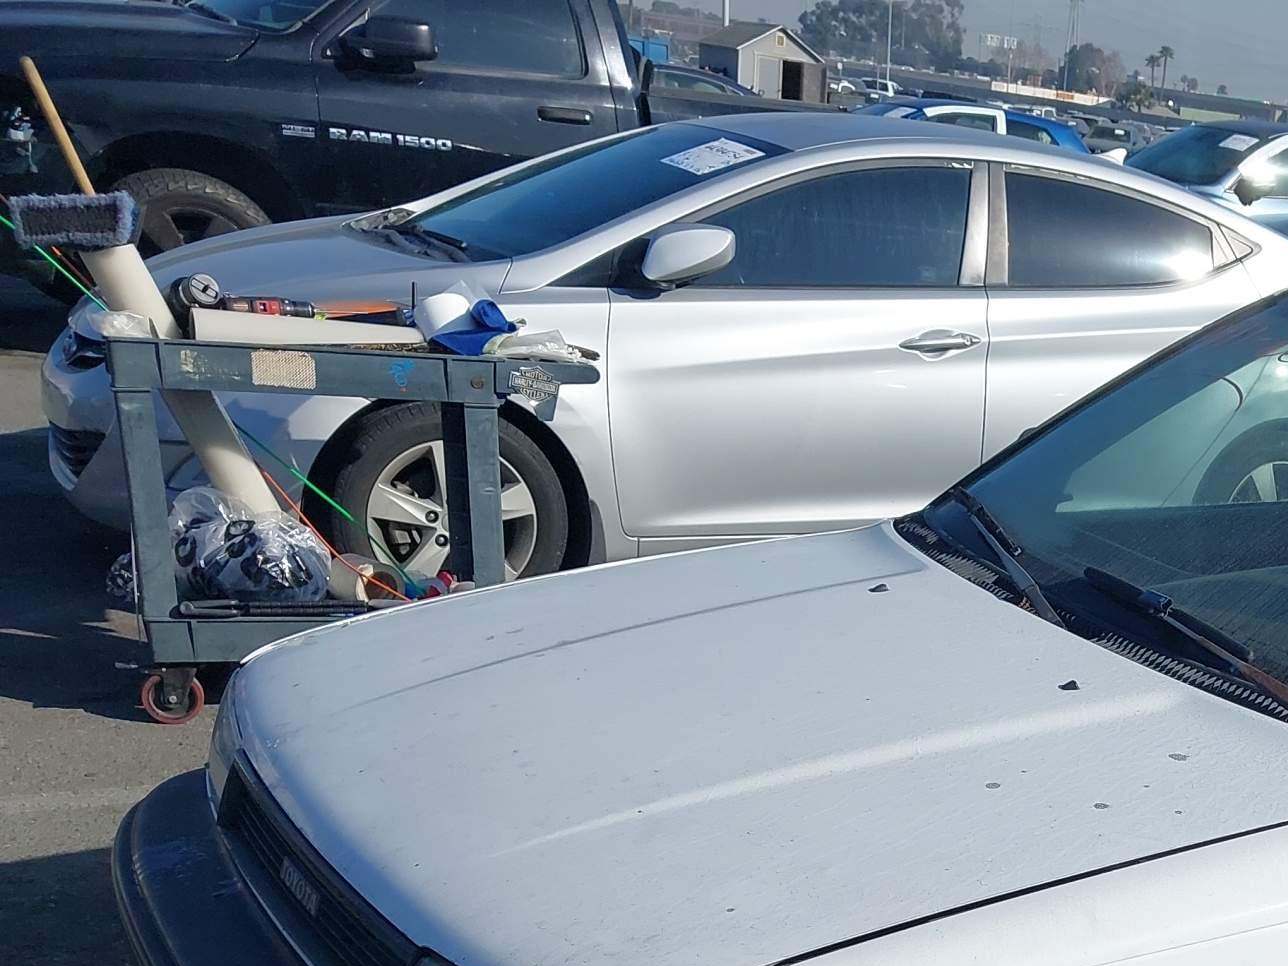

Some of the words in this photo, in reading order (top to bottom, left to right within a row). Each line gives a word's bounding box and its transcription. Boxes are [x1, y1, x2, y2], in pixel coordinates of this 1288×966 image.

[329, 127, 393, 145] RAM
[396, 134, 453, 151] 1500
[280, 856, 321, 917] TOYOTA
